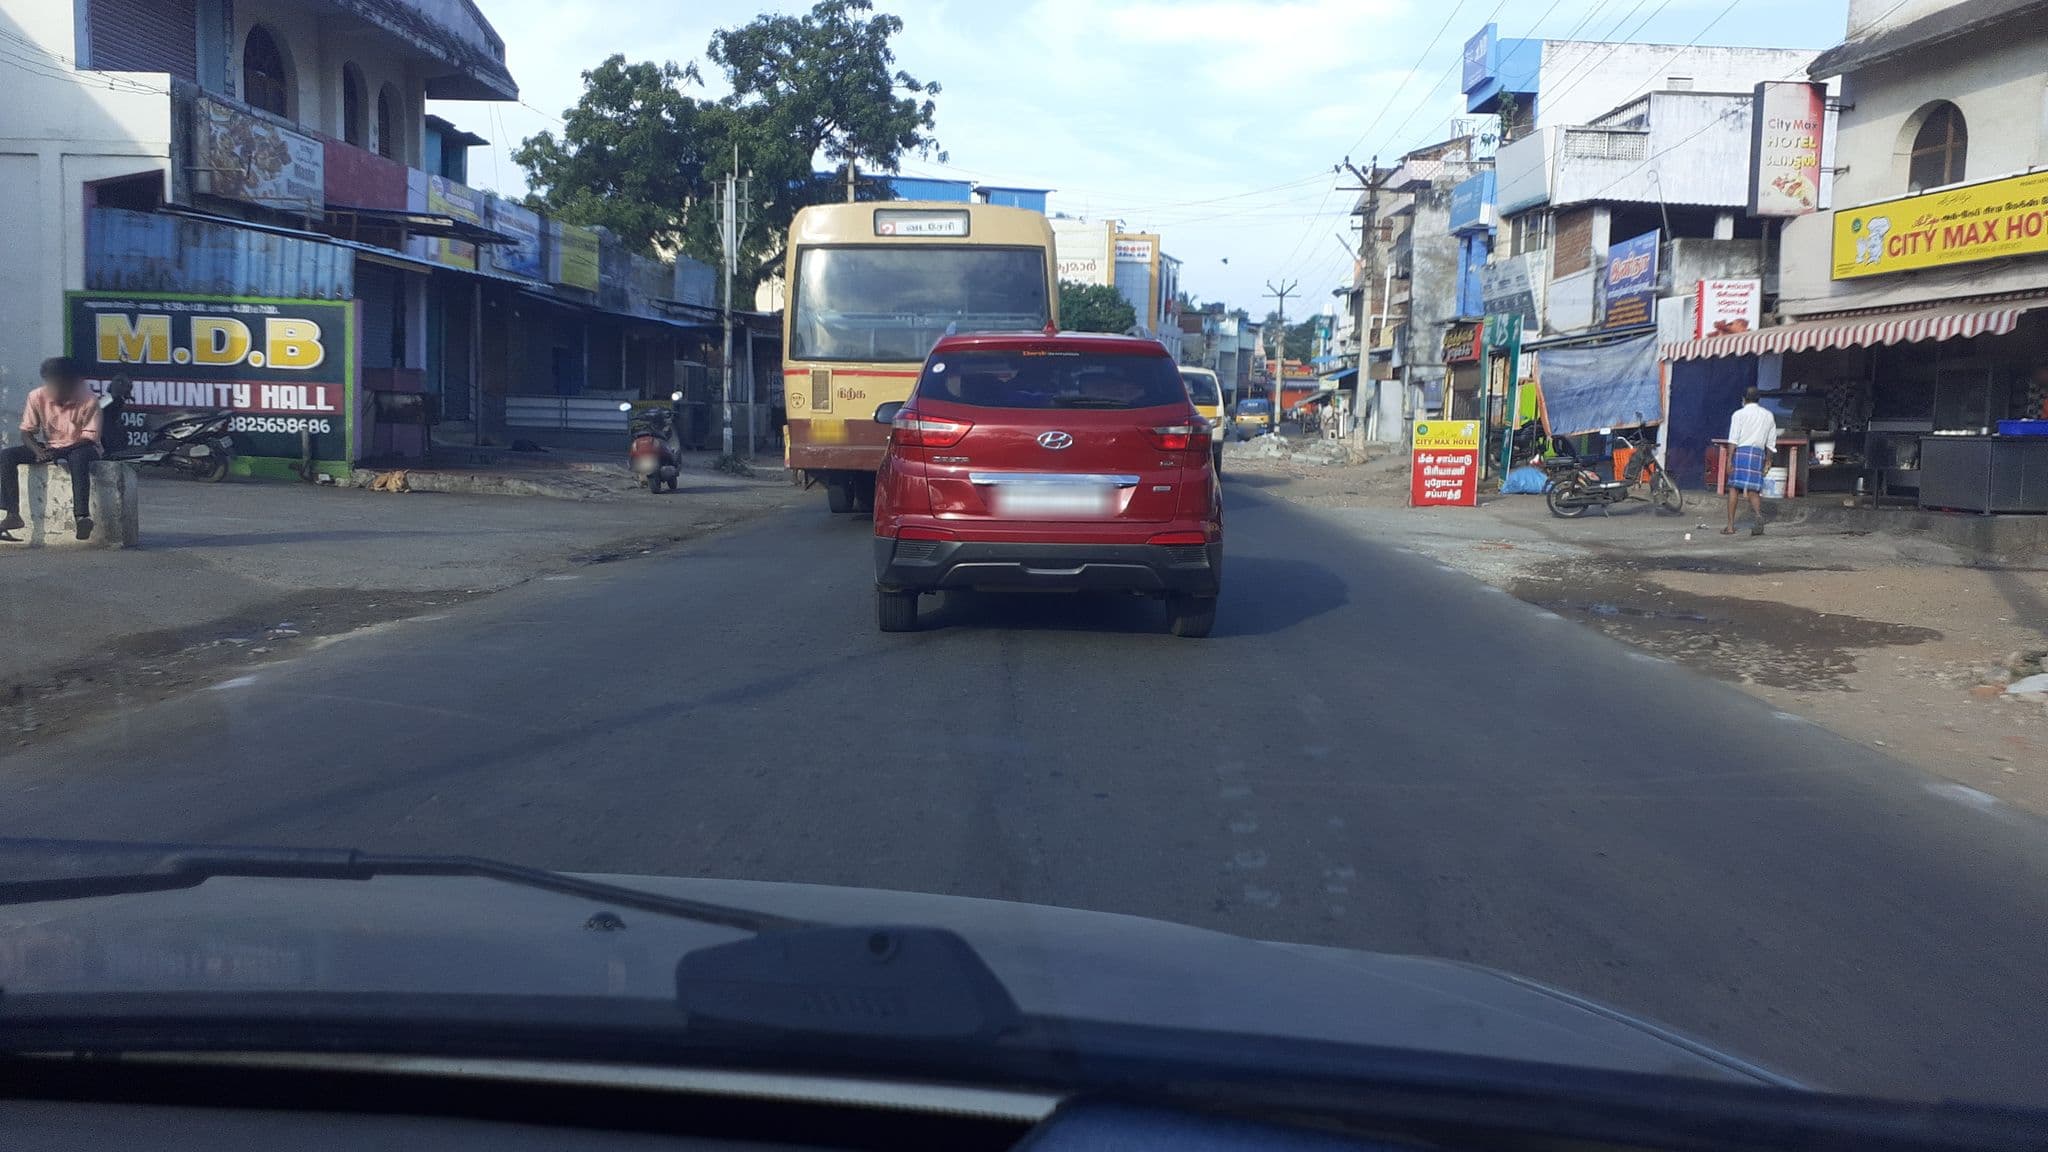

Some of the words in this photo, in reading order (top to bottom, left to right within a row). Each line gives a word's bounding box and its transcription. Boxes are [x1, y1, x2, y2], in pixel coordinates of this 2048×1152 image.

[1768, 119, 1791, 132] City
[1793, 119, 1818, 130] Max
[1767, 136, 1818, 149] HOTEL
[1888, 228, 1938, 258] CITY
[1942, 218, 1999, 251] MAX
[2007, 210, 2048, 241] HO
[95, 313, 325, 370] M.D.B
[261, 384, 334, 411] HALL
[1418, 452, 1434, 463] மீன்
